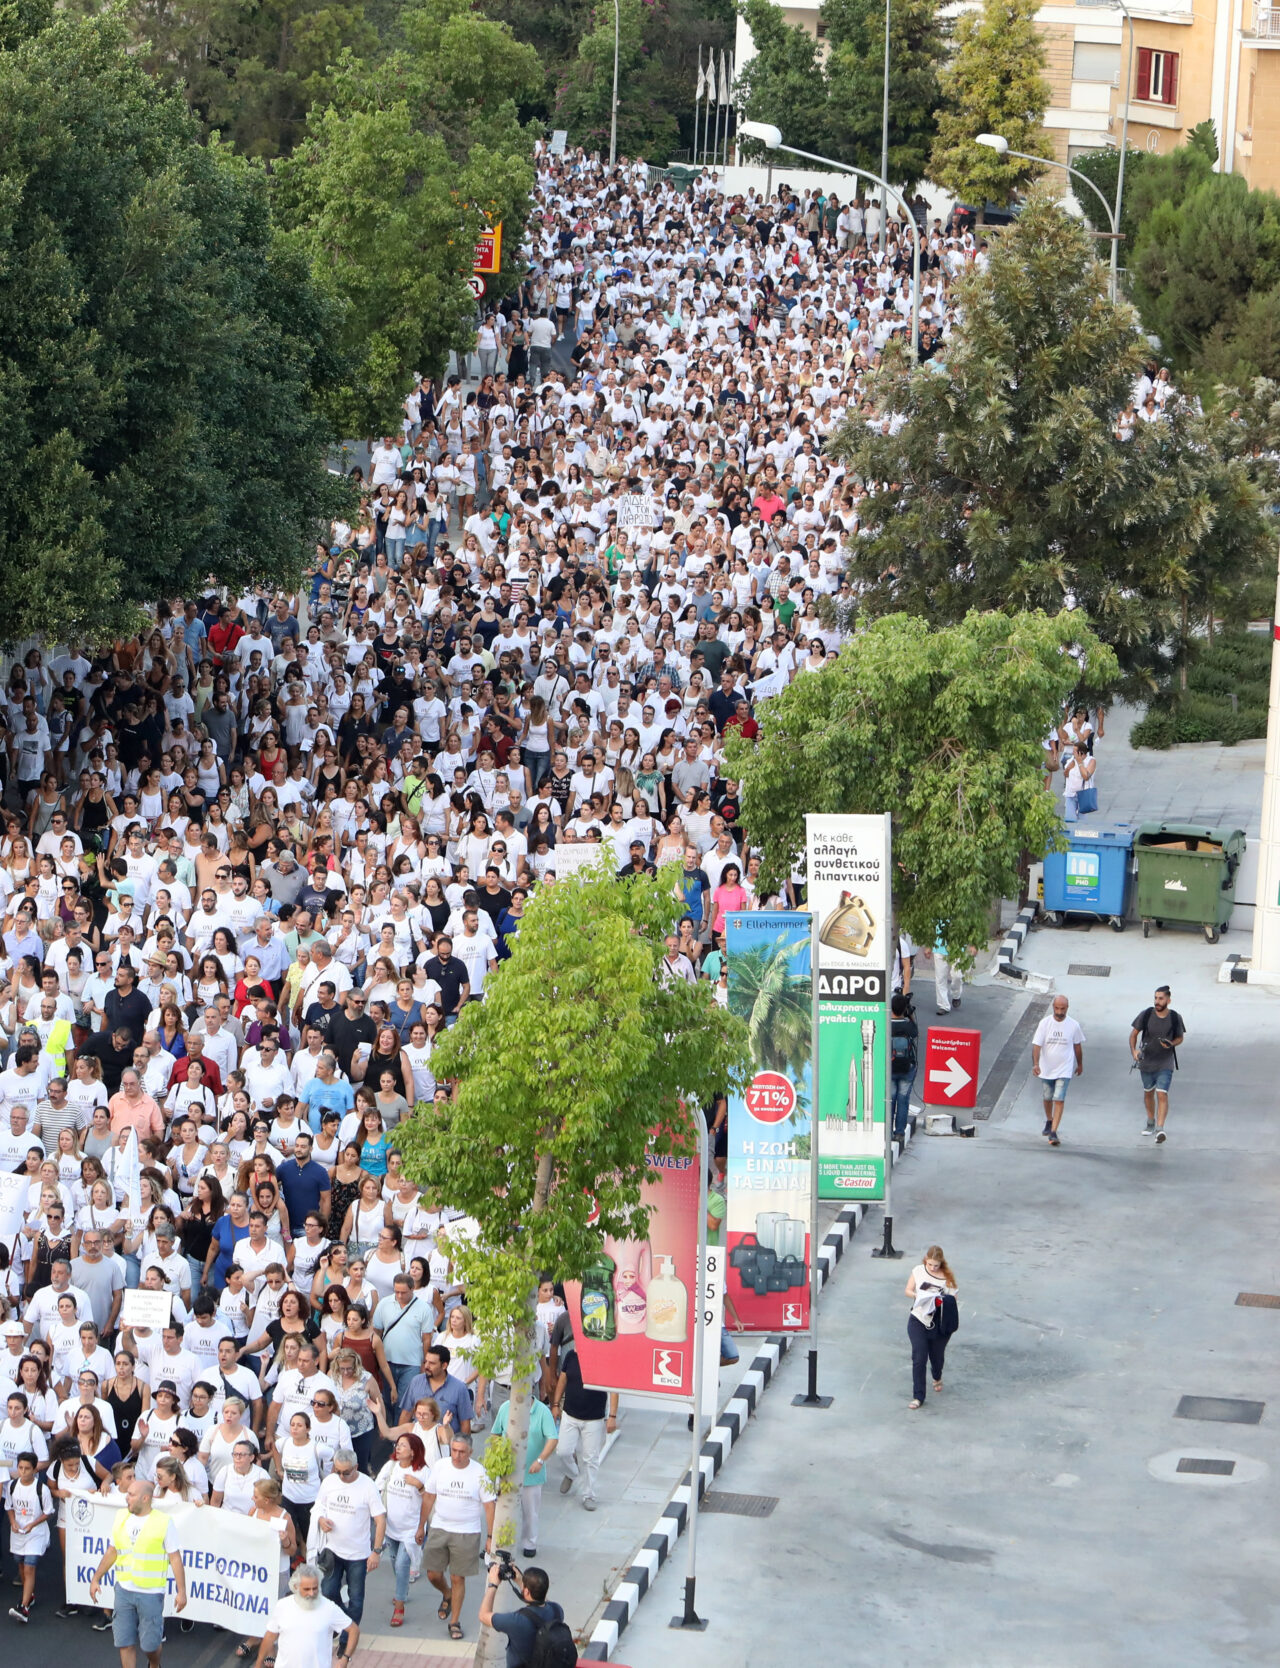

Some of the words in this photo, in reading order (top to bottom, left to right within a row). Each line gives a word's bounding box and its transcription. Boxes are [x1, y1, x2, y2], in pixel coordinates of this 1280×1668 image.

[814, 834, 828, 842] Με
[830, 834, 853, 842] κάθε
[814, 845, 857, 858] αλλαγή
[814, 858, 880, 869] συνθετικού
[814, 871, 880, 881] λιπαντικού
[746, 920, 804, 929] Ellehammer
[819, 975, 880, 996] ΔΩΡΟ
[819, 1003, 880, 1013] ολυχρηστικό
[820, 1014, 857, 1024] ργαλείο
[750, 1090, 790, 1106] 71%
[743, 1142, 754, 1154] Η
[760, 1142, 796, 1155] ΖΩΗ
[644, 1154, 693, 1170] SWEEP
[747, 1160, 792, 1172] ΕΙΝΑΙ
[733, 1176, 806, 1190] ΤΑΞΙΔΙΑ!
[844, 1178, 872, 1186] Castrol
[182, 1550, 268, 1583] ΠΕΡΘΩΡΙΟ
[190, 1581, 269, 1615] ΜΕΣΑΙΩΝΑ
